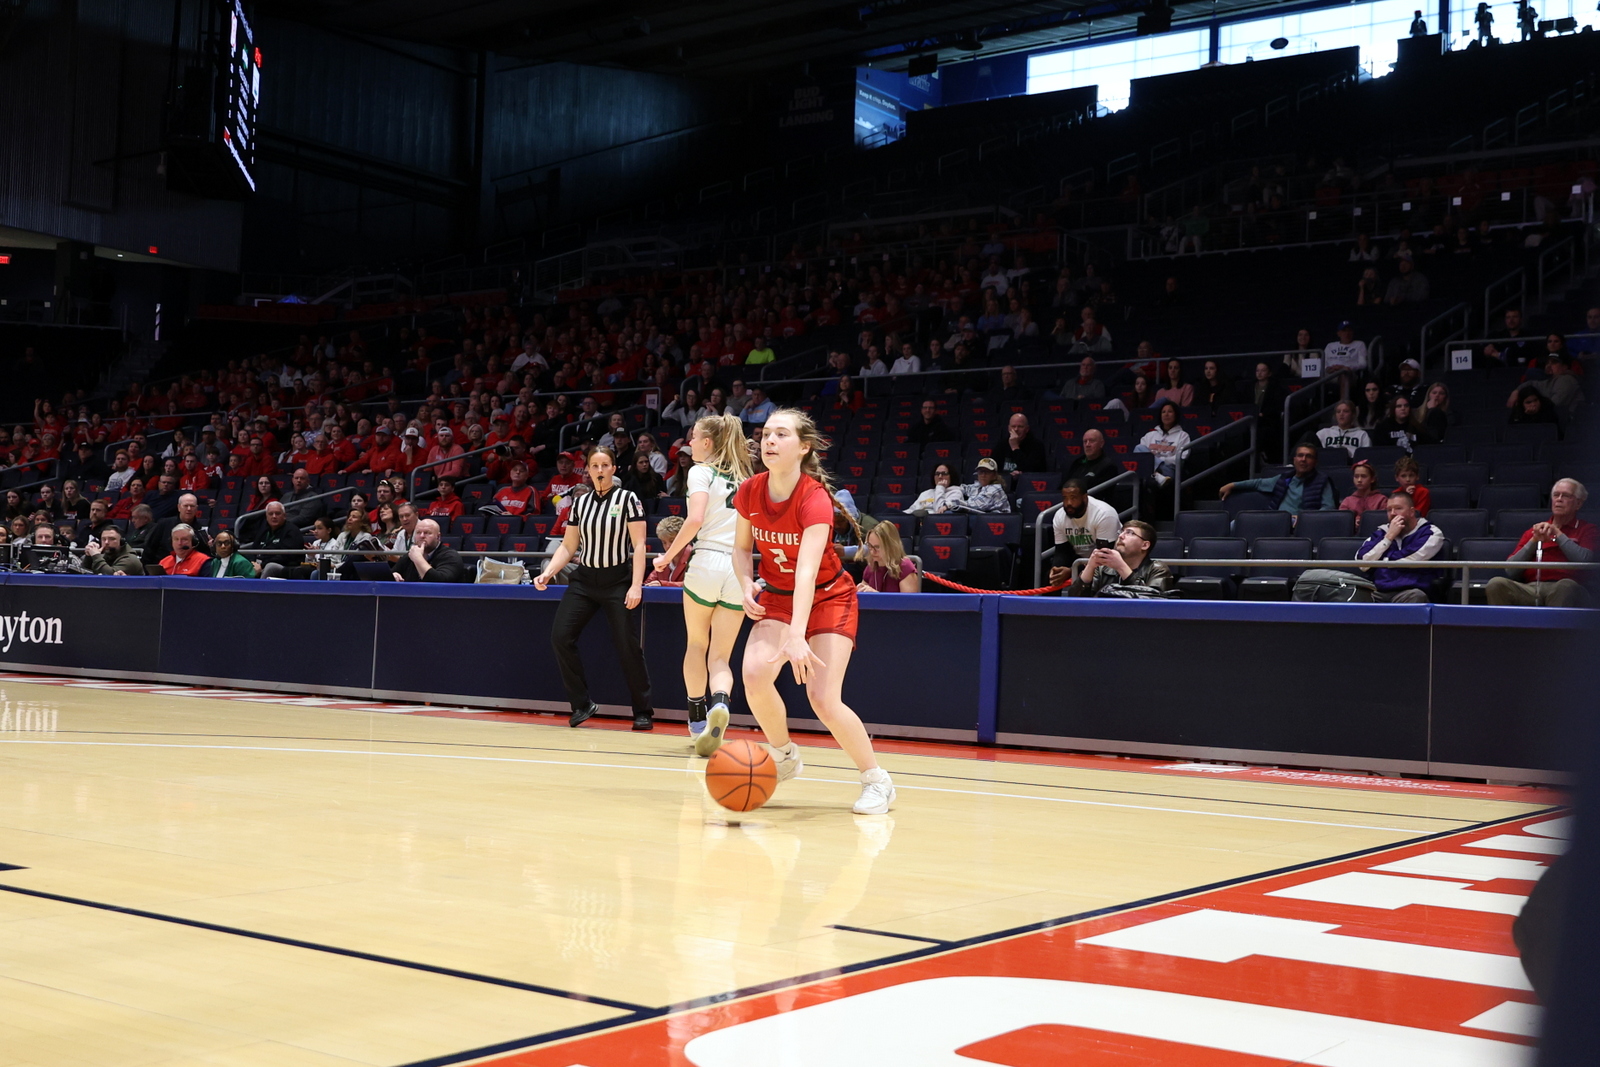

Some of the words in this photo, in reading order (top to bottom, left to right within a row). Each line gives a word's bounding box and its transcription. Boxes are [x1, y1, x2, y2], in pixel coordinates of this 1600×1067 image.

[859, 89, 869, 99] Keep
[778, 109, 834, 128] LANDING
[1325, 436, 1360, 447] OHIO
[769, 548, 795, 573] 2
